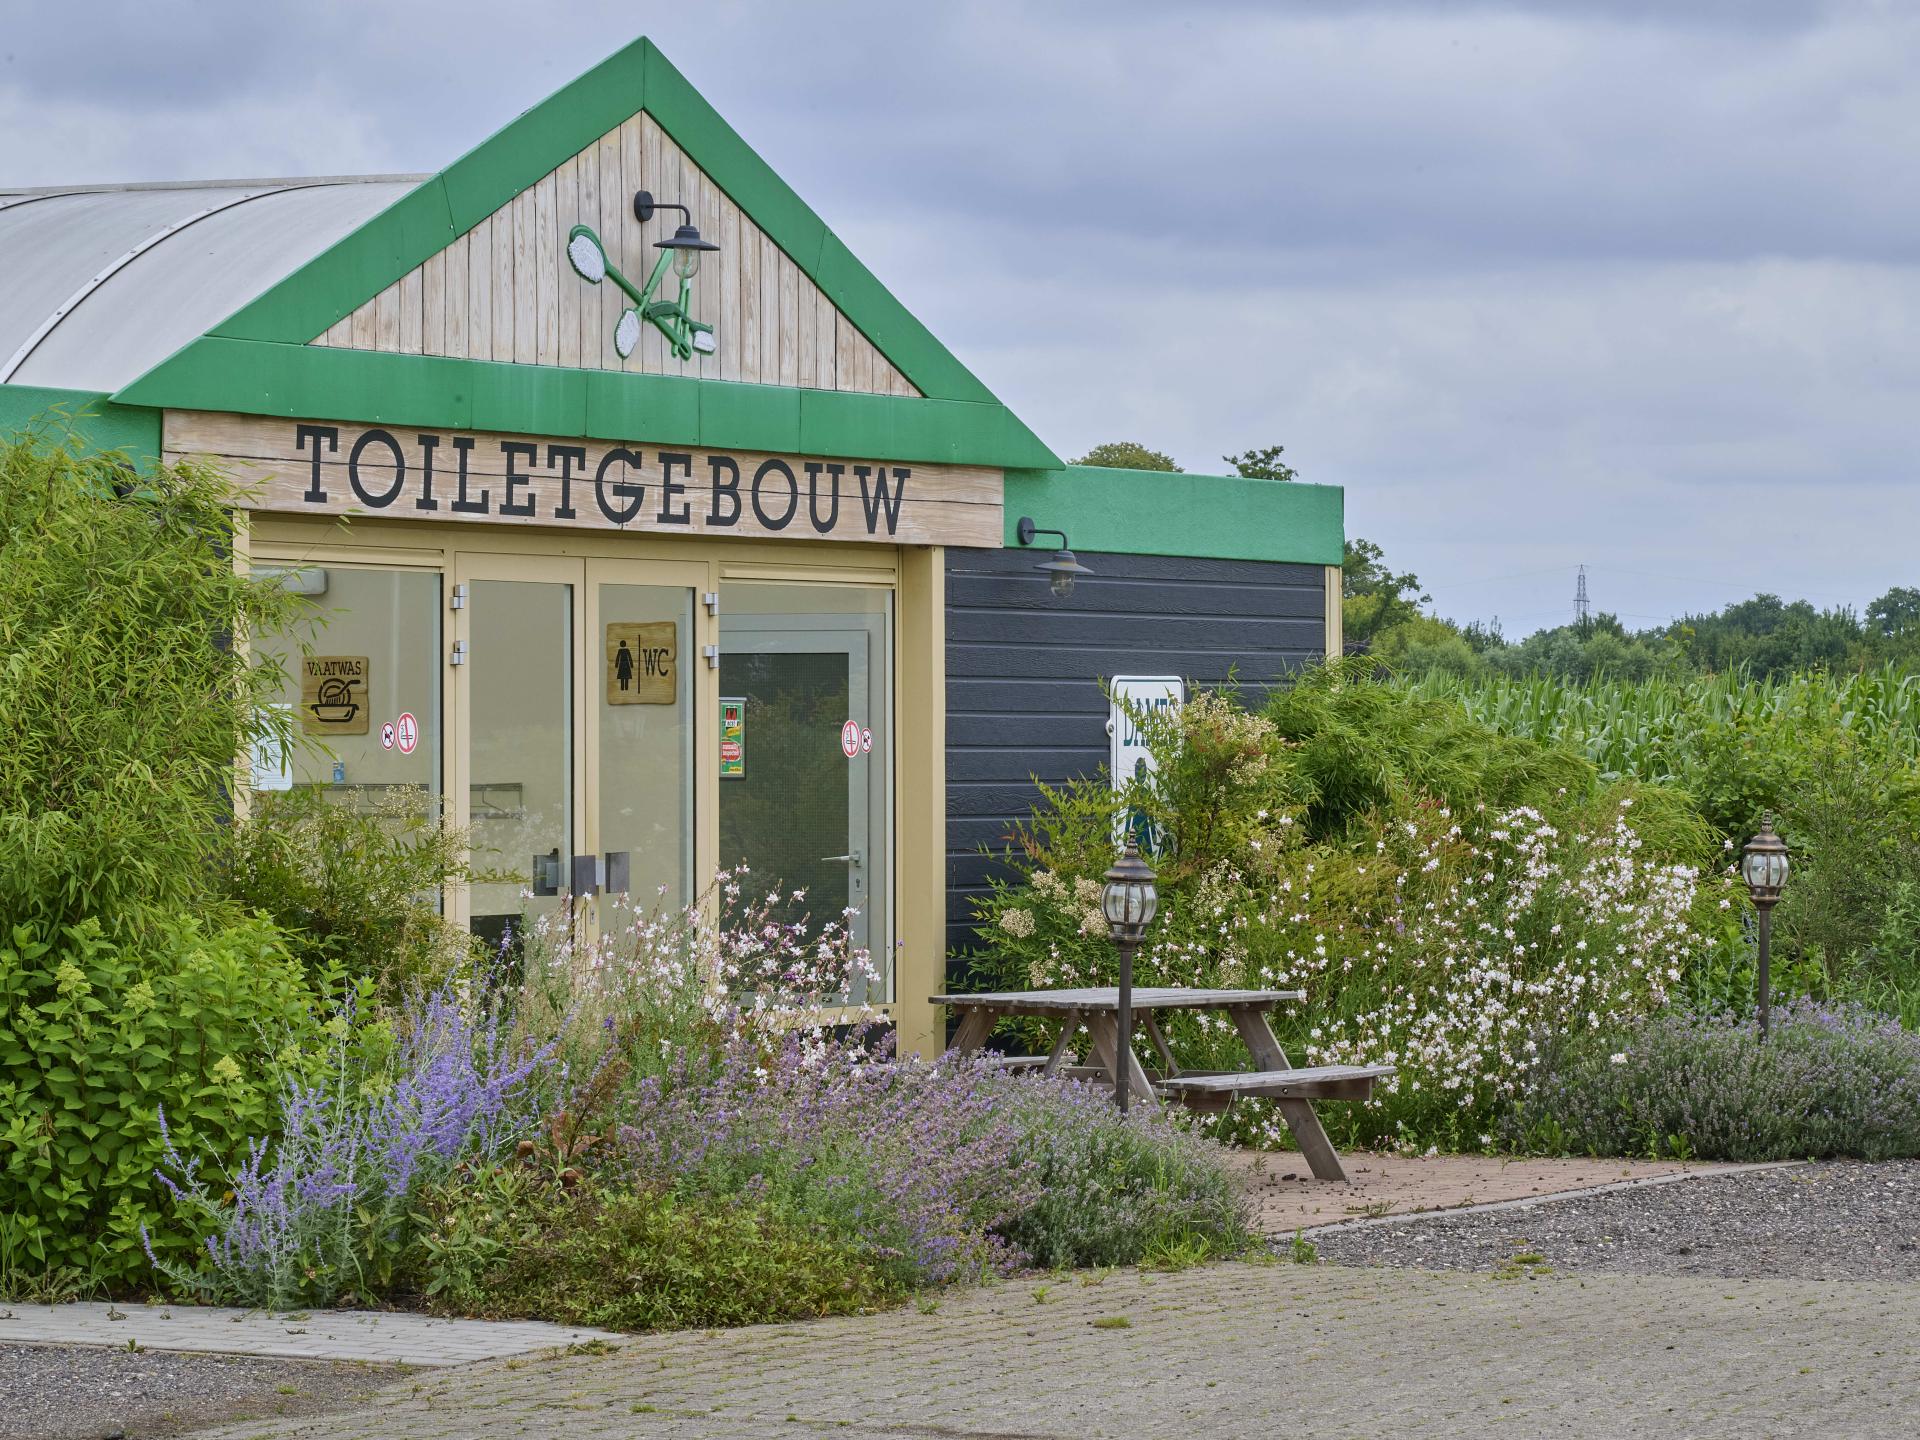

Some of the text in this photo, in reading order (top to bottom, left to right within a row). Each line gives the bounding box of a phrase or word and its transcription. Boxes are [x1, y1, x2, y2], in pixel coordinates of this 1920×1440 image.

[295, 423, 912, 536] TOILETGEBOUW
[307, 661, 362, 676] VAATWAS
[642, 648, 669, 677] WC
